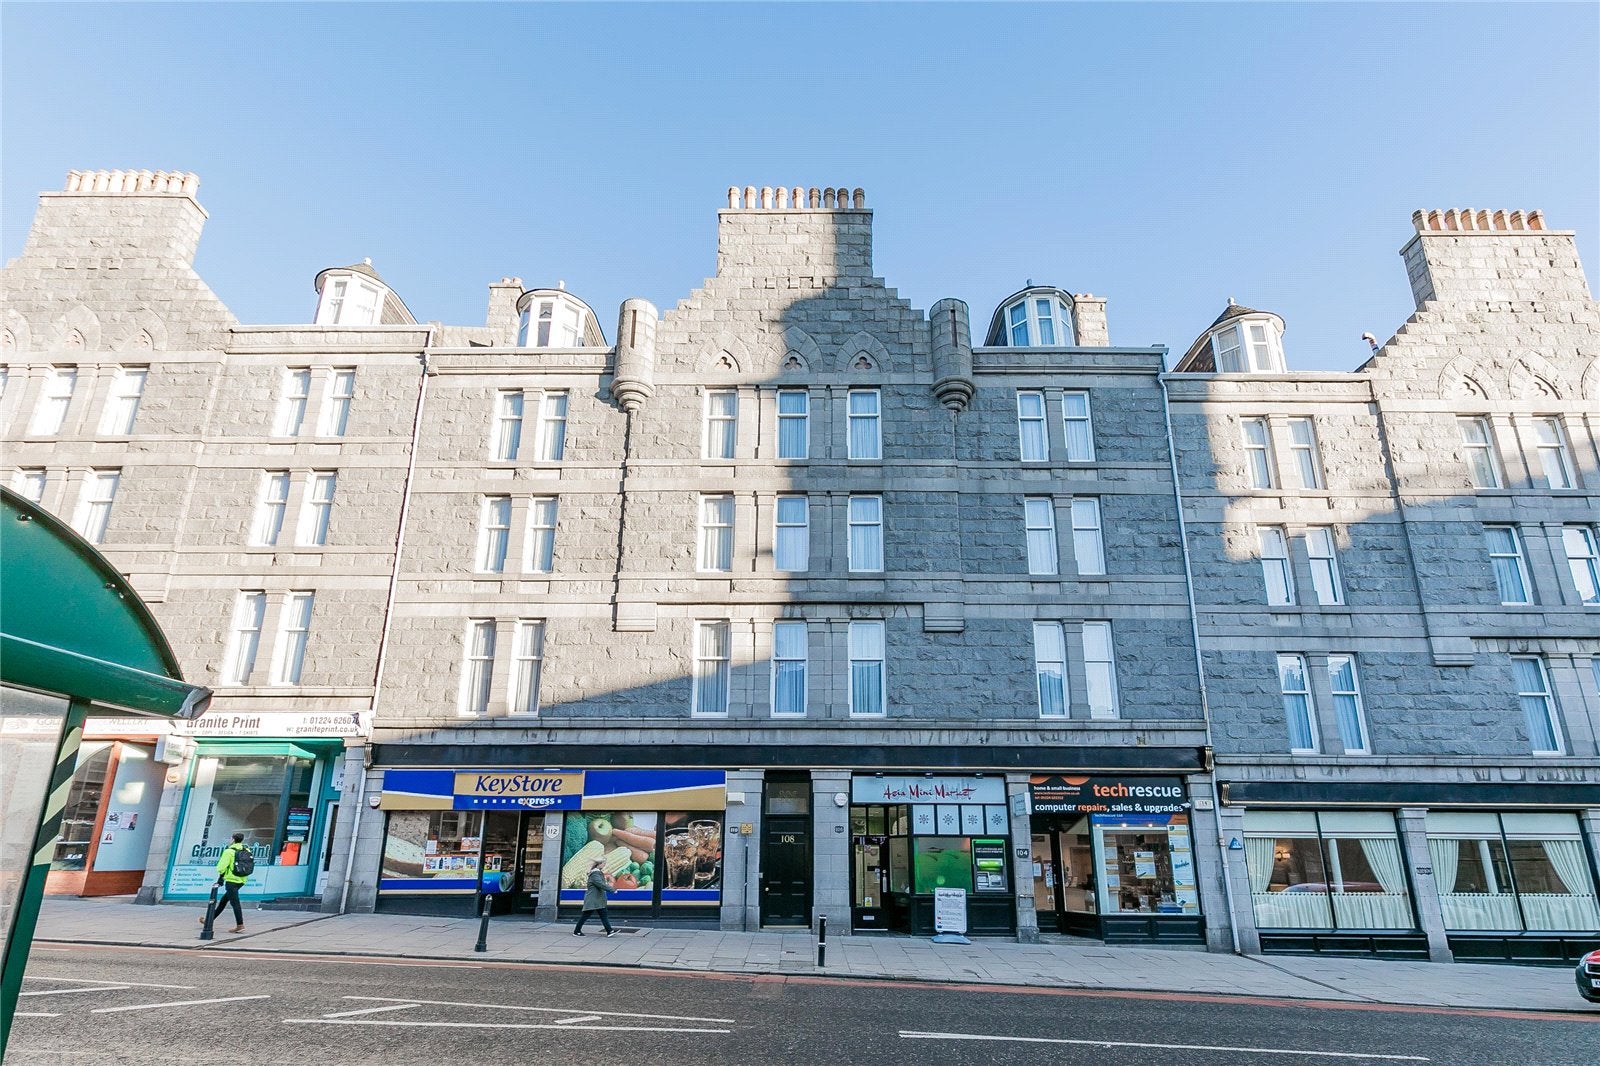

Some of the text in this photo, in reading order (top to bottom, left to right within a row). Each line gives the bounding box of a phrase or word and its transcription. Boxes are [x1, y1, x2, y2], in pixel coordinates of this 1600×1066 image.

[232, 715, 261, 728] Print
[309, 716, 332, 725] 01224
[295, 725, 359, 734] graniteprint.co.uk
[475, 775, 563, 794] KeyStore
[883, 783, 978, 800] Asia Mini Market
[1092, 783, 1182, 798] techrescue
[517, 797, 555, 806] express
[1034, 804, 1076, 813] computer
[1077, 803, 1110, 813] repairs,
[1111, 803, 1132, 812] sales
[1134, 804, 1143, 812] &
[1144, 803, 1184, 814] upgrades
[781, 835, 795, 843] 108
